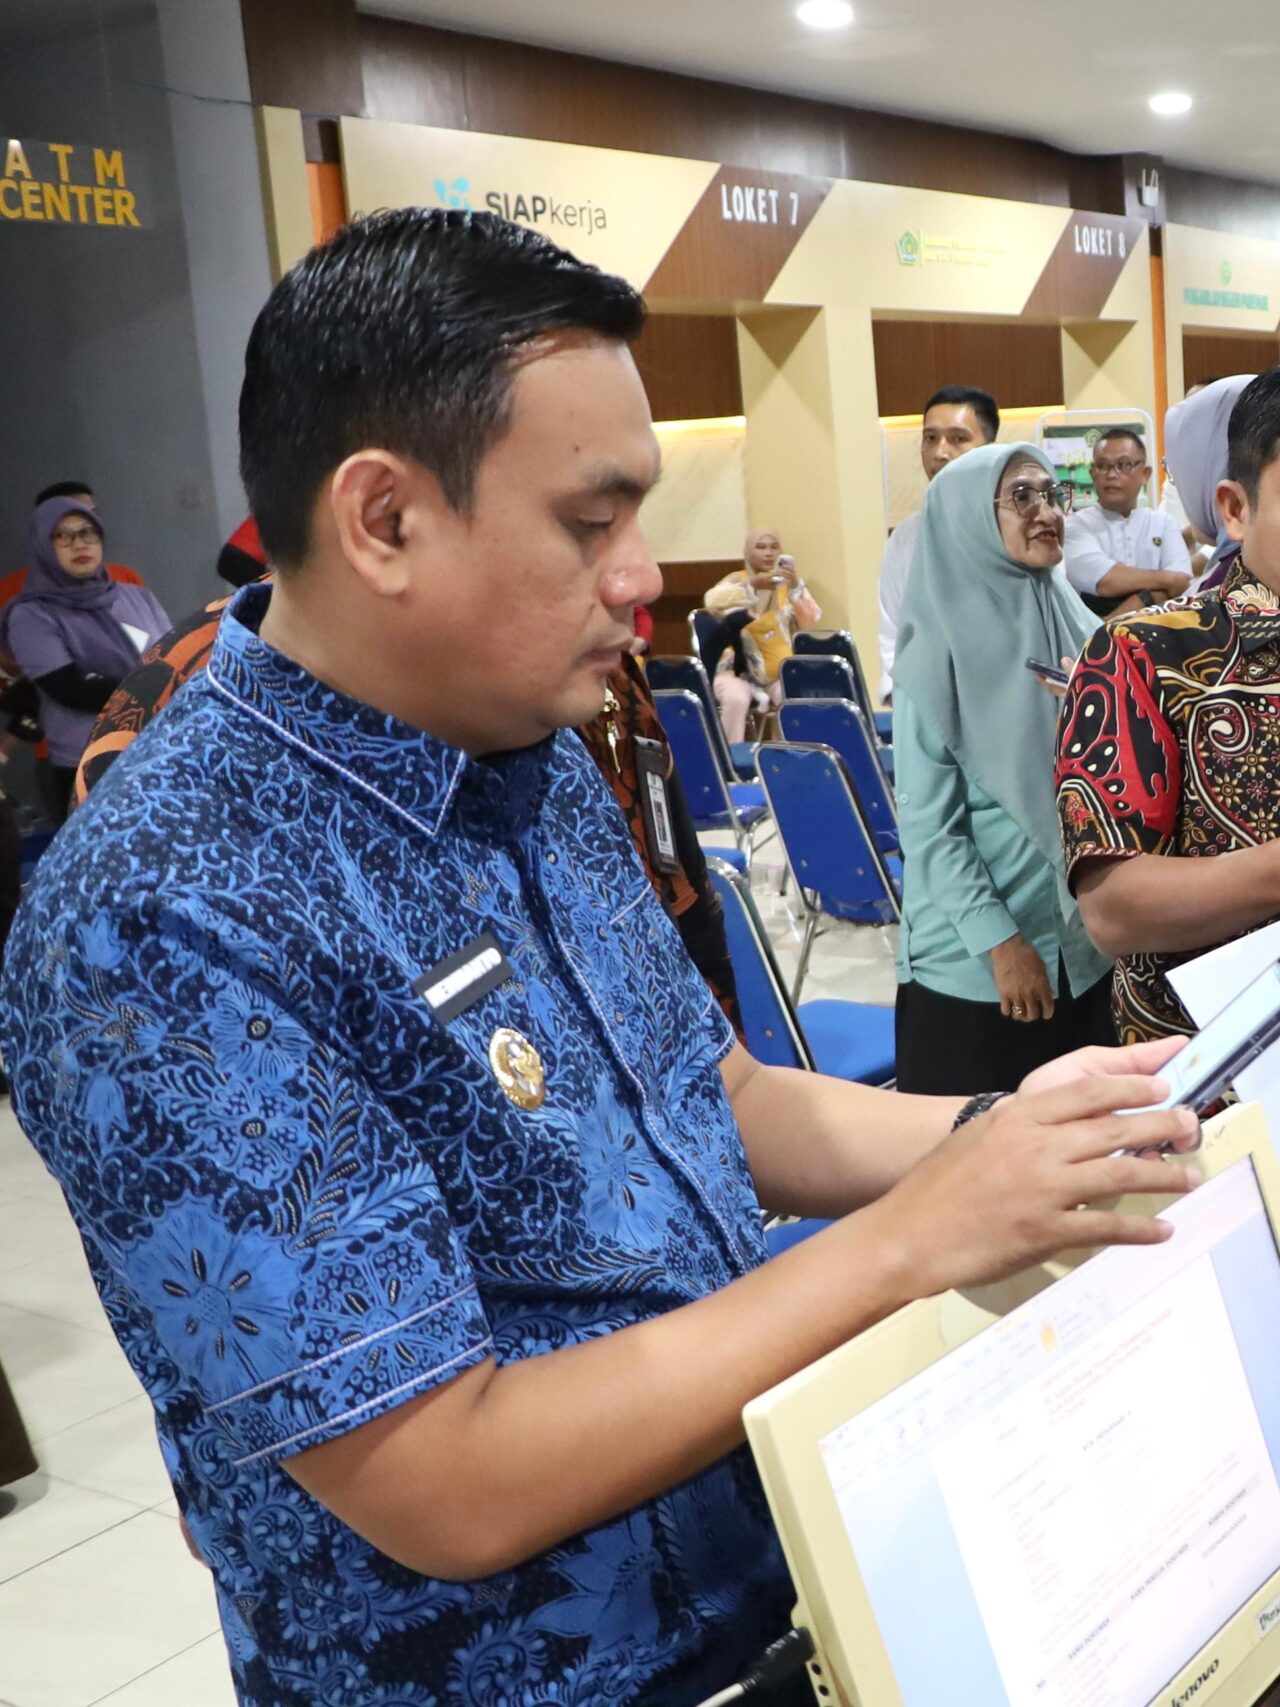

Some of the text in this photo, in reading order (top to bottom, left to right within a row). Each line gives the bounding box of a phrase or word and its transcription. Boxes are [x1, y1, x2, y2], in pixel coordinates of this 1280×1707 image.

[0, 178, 140, 226] CENTER
[486, 191, 606, 235] SIAPkerja
[721, 184, 799, 226] LOKET 7
[1074, 224, 1126, 259] LOKET 8
